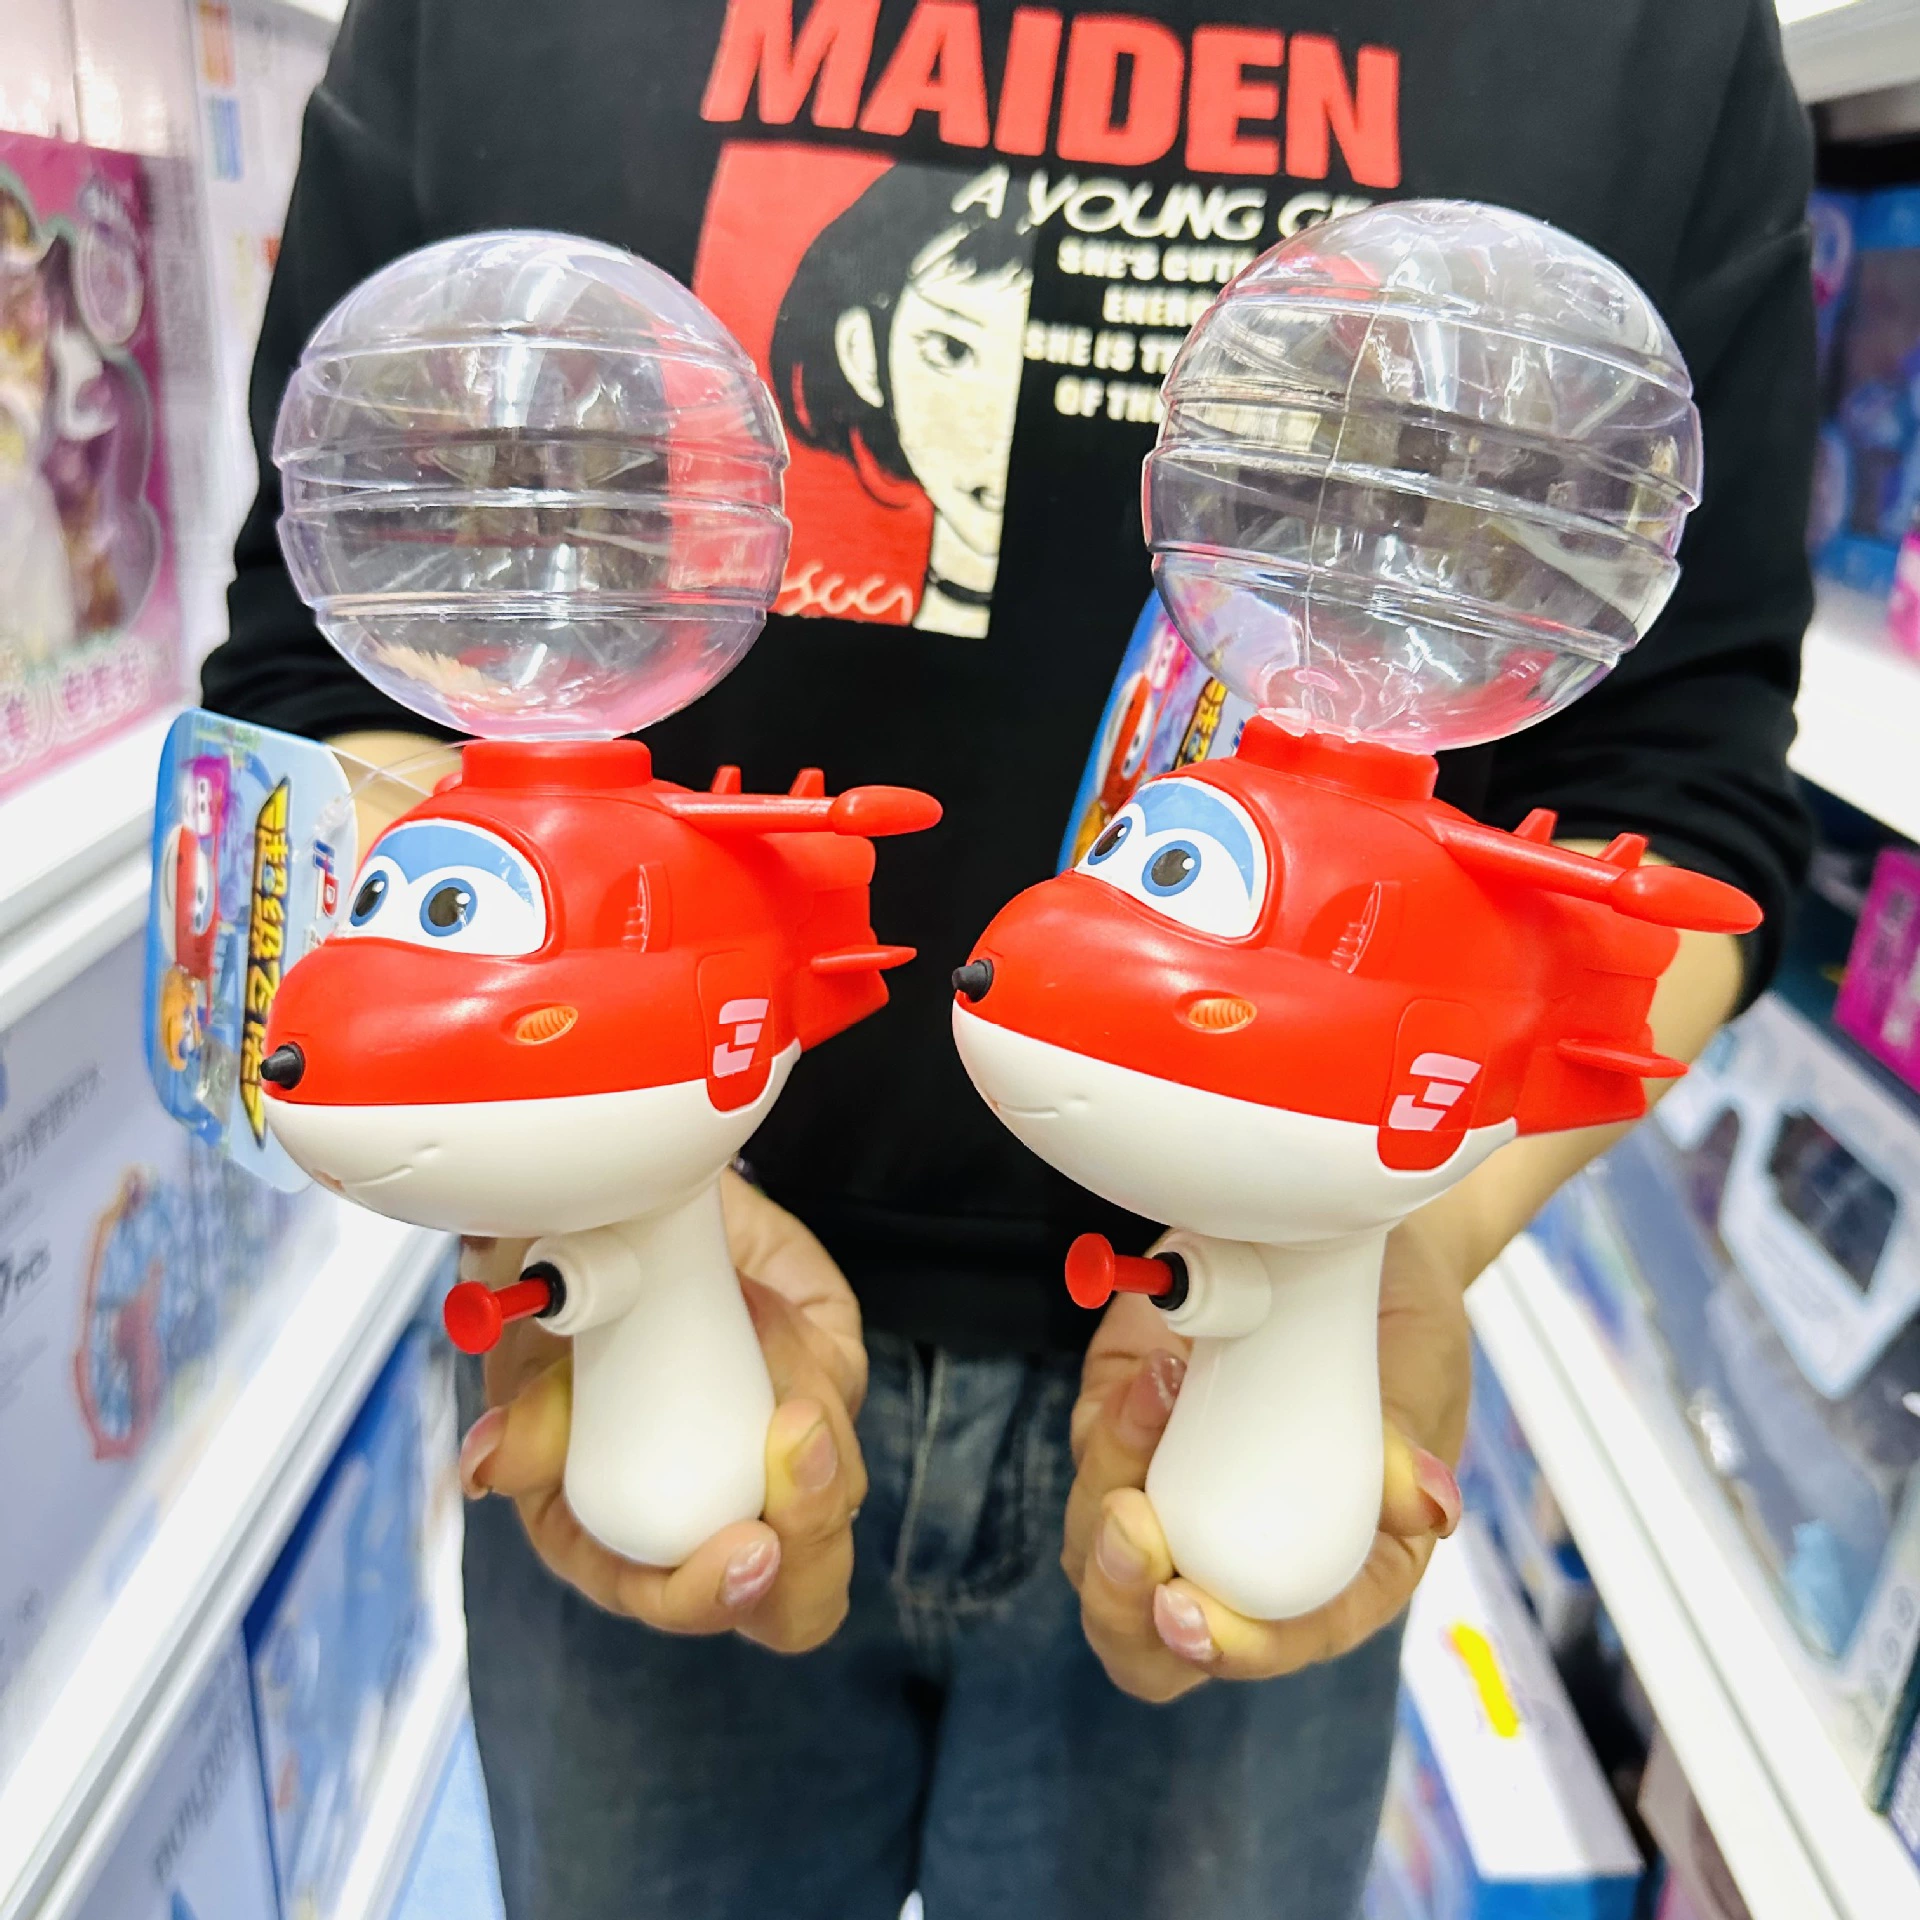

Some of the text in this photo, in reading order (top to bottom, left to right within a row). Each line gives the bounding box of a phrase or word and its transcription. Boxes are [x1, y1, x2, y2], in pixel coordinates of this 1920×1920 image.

[700, 0, 1400, 189] MAIDEN
[951, 164, 1010, 219] A
[1025, 170, 1268, 242] YOUNG
[1024, 320, 1093, 367] SHE
[1093, 329, 1136, 373] IS
[1053, 375, 1105, 418] OF
